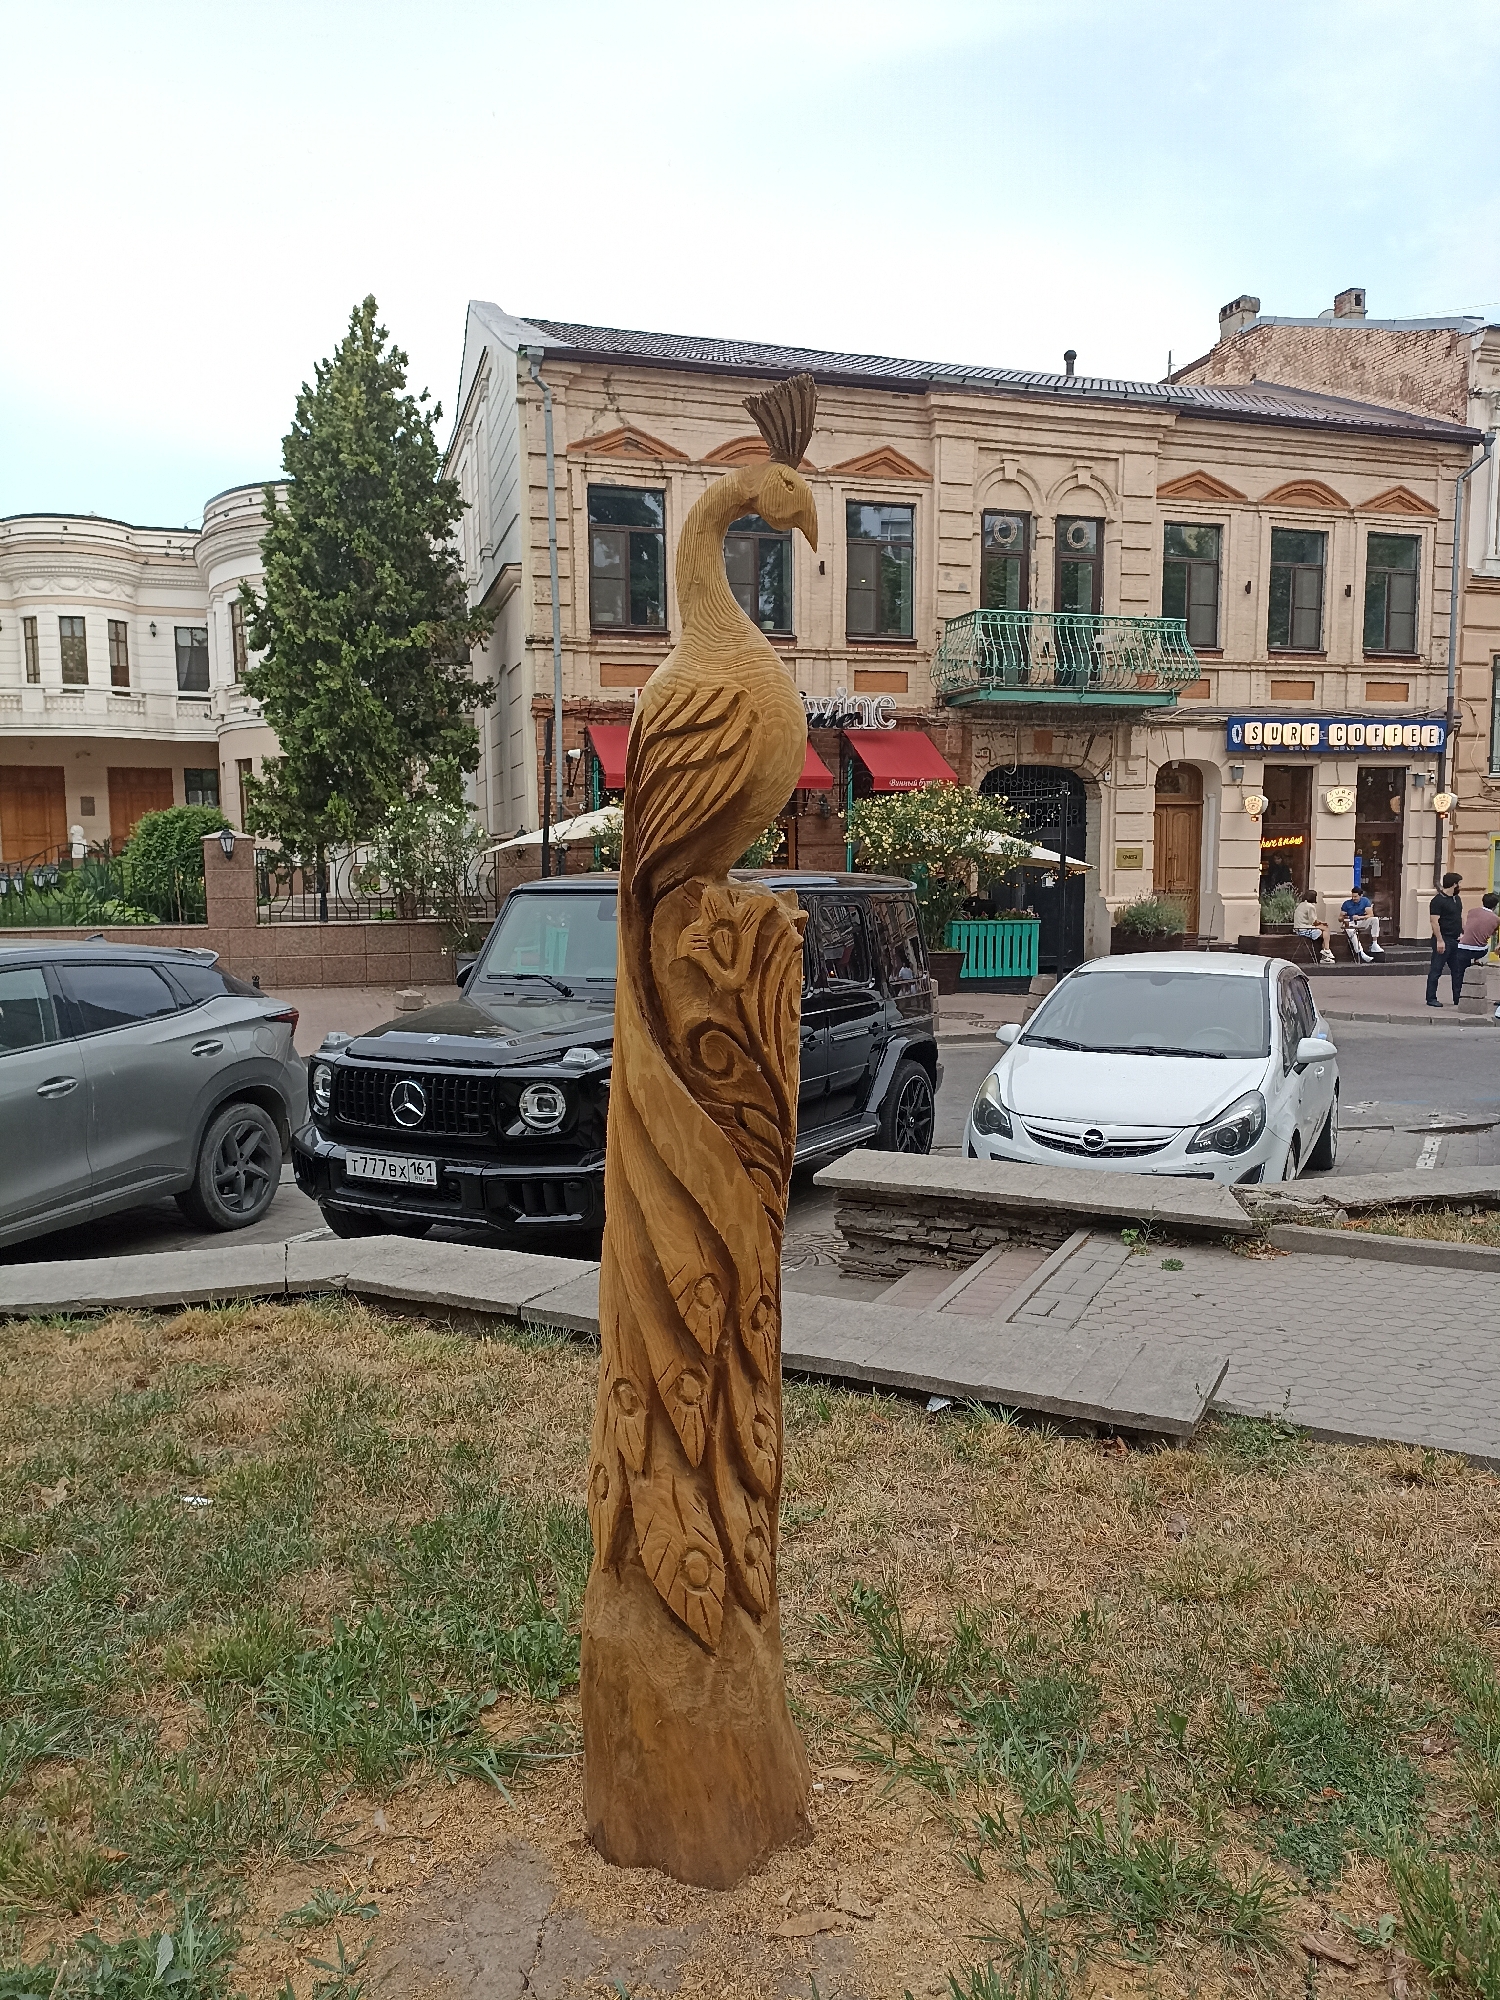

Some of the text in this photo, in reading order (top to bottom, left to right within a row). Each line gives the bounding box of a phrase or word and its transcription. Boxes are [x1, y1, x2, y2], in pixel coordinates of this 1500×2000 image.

[1251, 725, 1436, 744] SURF COFFEE
[888, 779, 918, 787] Винный
[1261, 837, 1277, 848] here
[410, 1161, 433, 1176] 161
